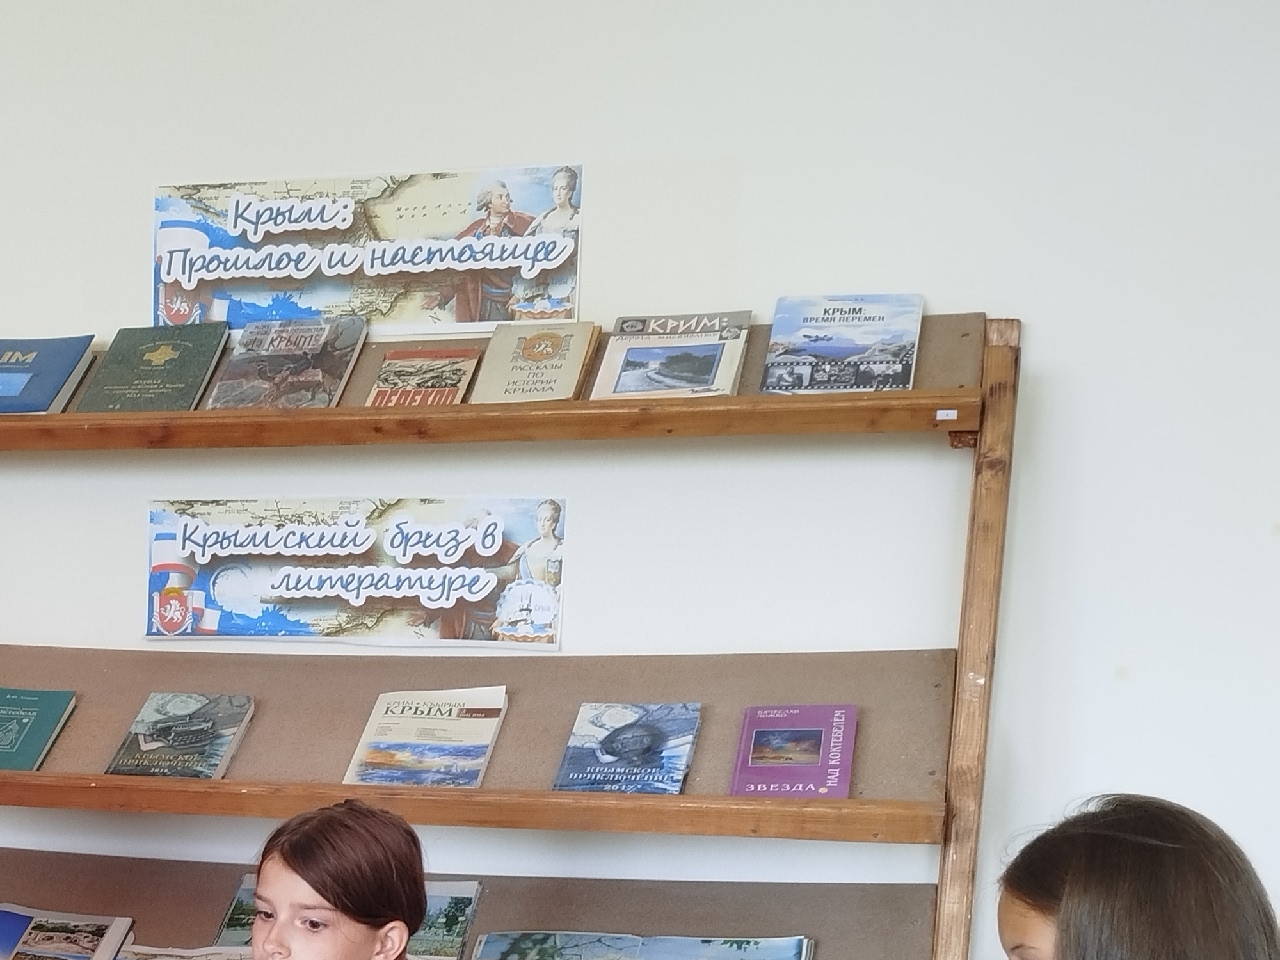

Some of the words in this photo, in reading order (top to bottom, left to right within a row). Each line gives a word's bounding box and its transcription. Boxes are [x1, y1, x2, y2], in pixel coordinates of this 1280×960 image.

[232, 198, 352, 236] Крым:
[166, 247, 316, 284] Прошлое
[326, 244, 359, 269] и
[368, 237, 567, 273] настоящее
[802, 316, 836, 324] ВРЕМЯ
[838, 315, 885, 323] ПЕРЕМЕН
[510, 363, 564, 372] РАССКАЗЫ
[526, 371, 545, 379] ПО
[506, 378, 558, 387] ИСТОРИИ
[503, 386, 555, 395] КРЫМА
[181, 519, 371, 558] Крымский
[389, 519, 471, 560] бриз
[479, 521, 500, 549] в
[271, 568, 491, 602] литературе
[383, 706, 453, 718] КРЫМ
[828, 709, 846, 765] КОКТЕБЕЛЕМ
[826, 768, 841, 787] НАД
[745, 783, 817, 792] ЗВЕЗДА
